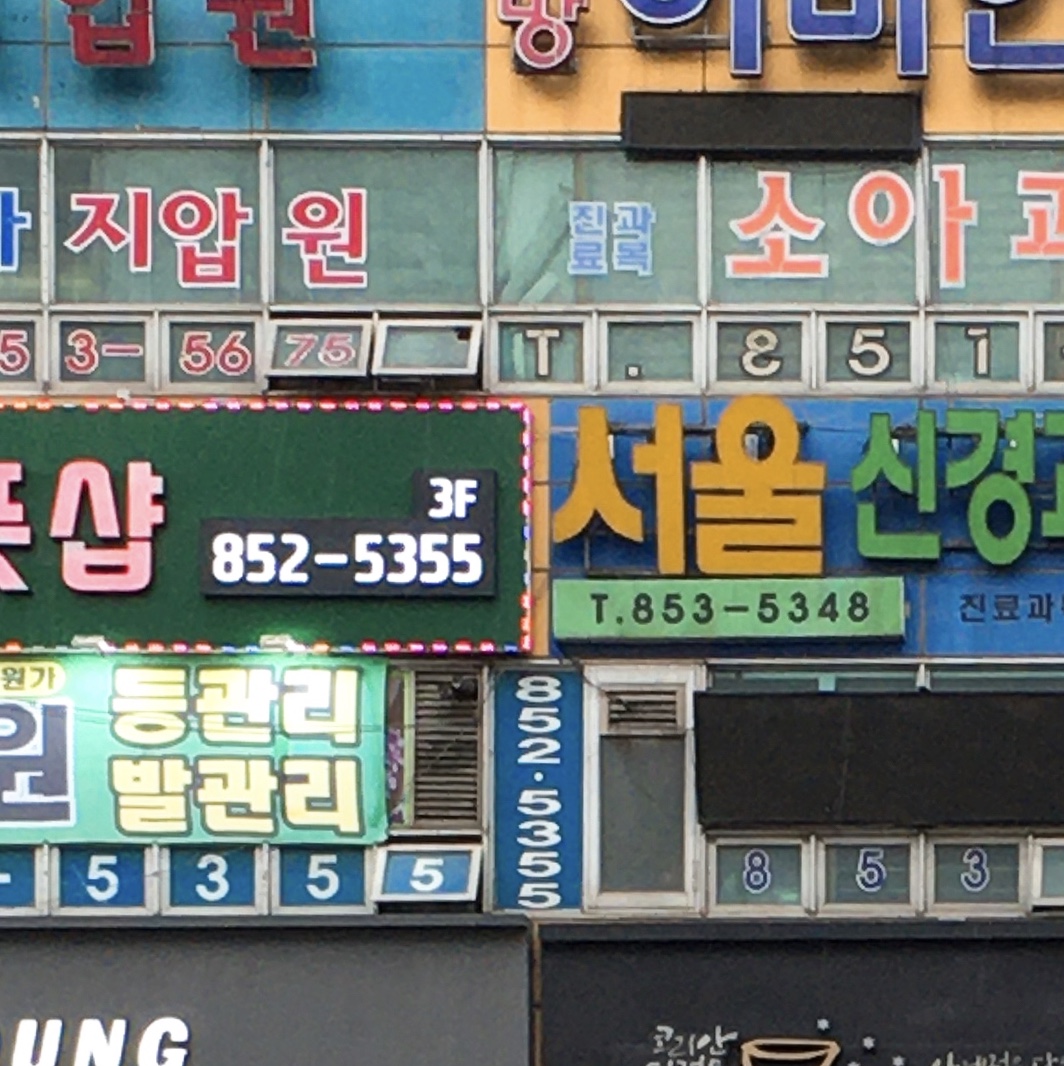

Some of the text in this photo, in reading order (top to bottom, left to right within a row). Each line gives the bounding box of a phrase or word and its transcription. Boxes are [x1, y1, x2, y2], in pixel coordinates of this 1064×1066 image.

[428, 477, 478, 520] 3F
[552, 394, 827, 577] 서울
[211, 532, 483, 585] 852-5355
[590, 592, 872, 627] T.853-5348
[109, 665, 362, 747] 등관리
[109, 755, 364, 837] 발관리
[652, 1025, 739, 1056] 코리안
